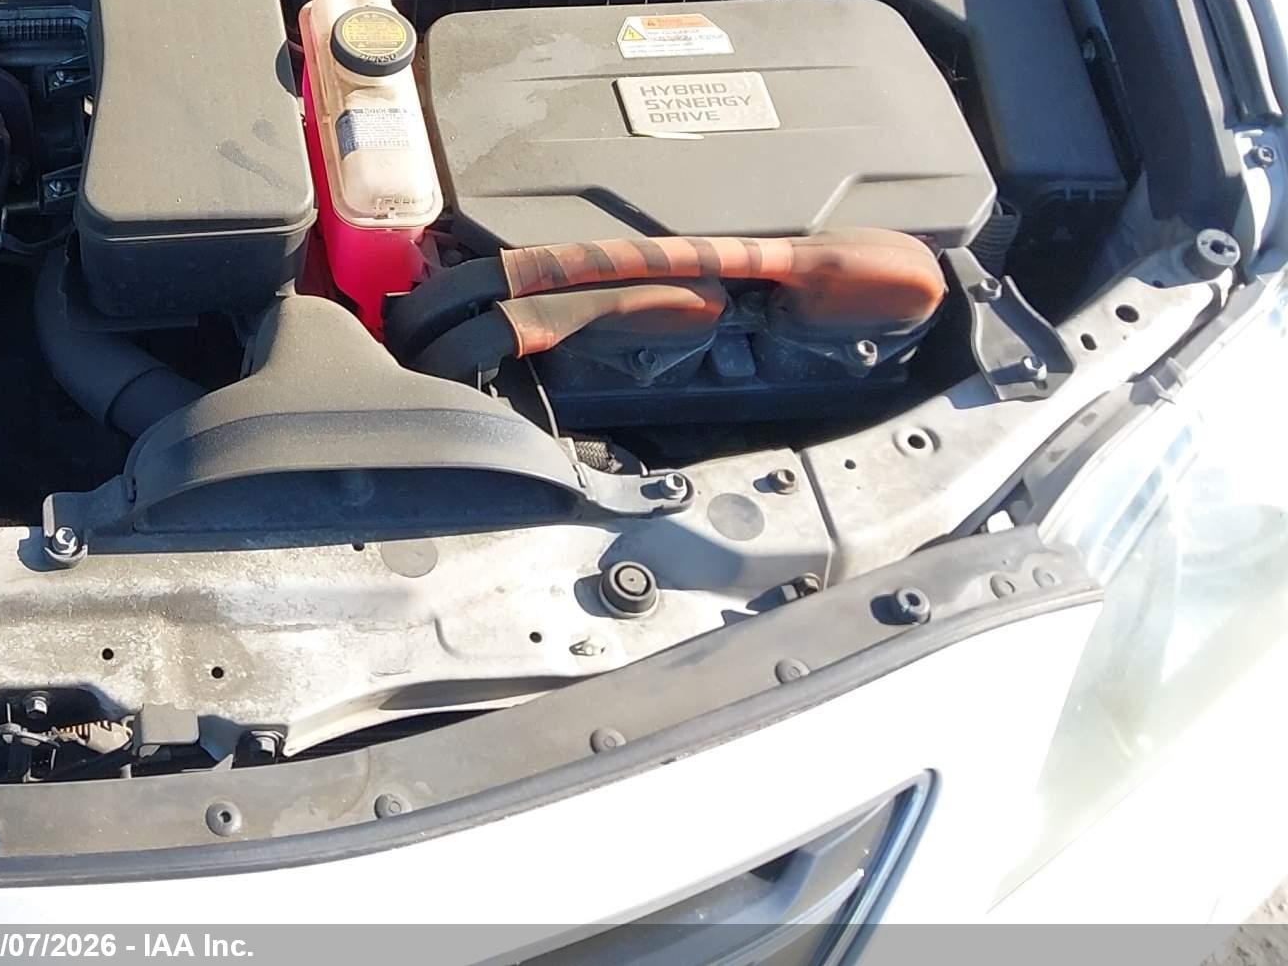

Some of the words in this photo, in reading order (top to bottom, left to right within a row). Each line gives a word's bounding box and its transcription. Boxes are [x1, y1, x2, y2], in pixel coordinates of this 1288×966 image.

[359, 53, 396, 63] DENSO
[640, 83, 727, 96] HYBRID
[644, 95, 752, 110] SYNERGY
[648, 110, 720, 123] DRIVE
